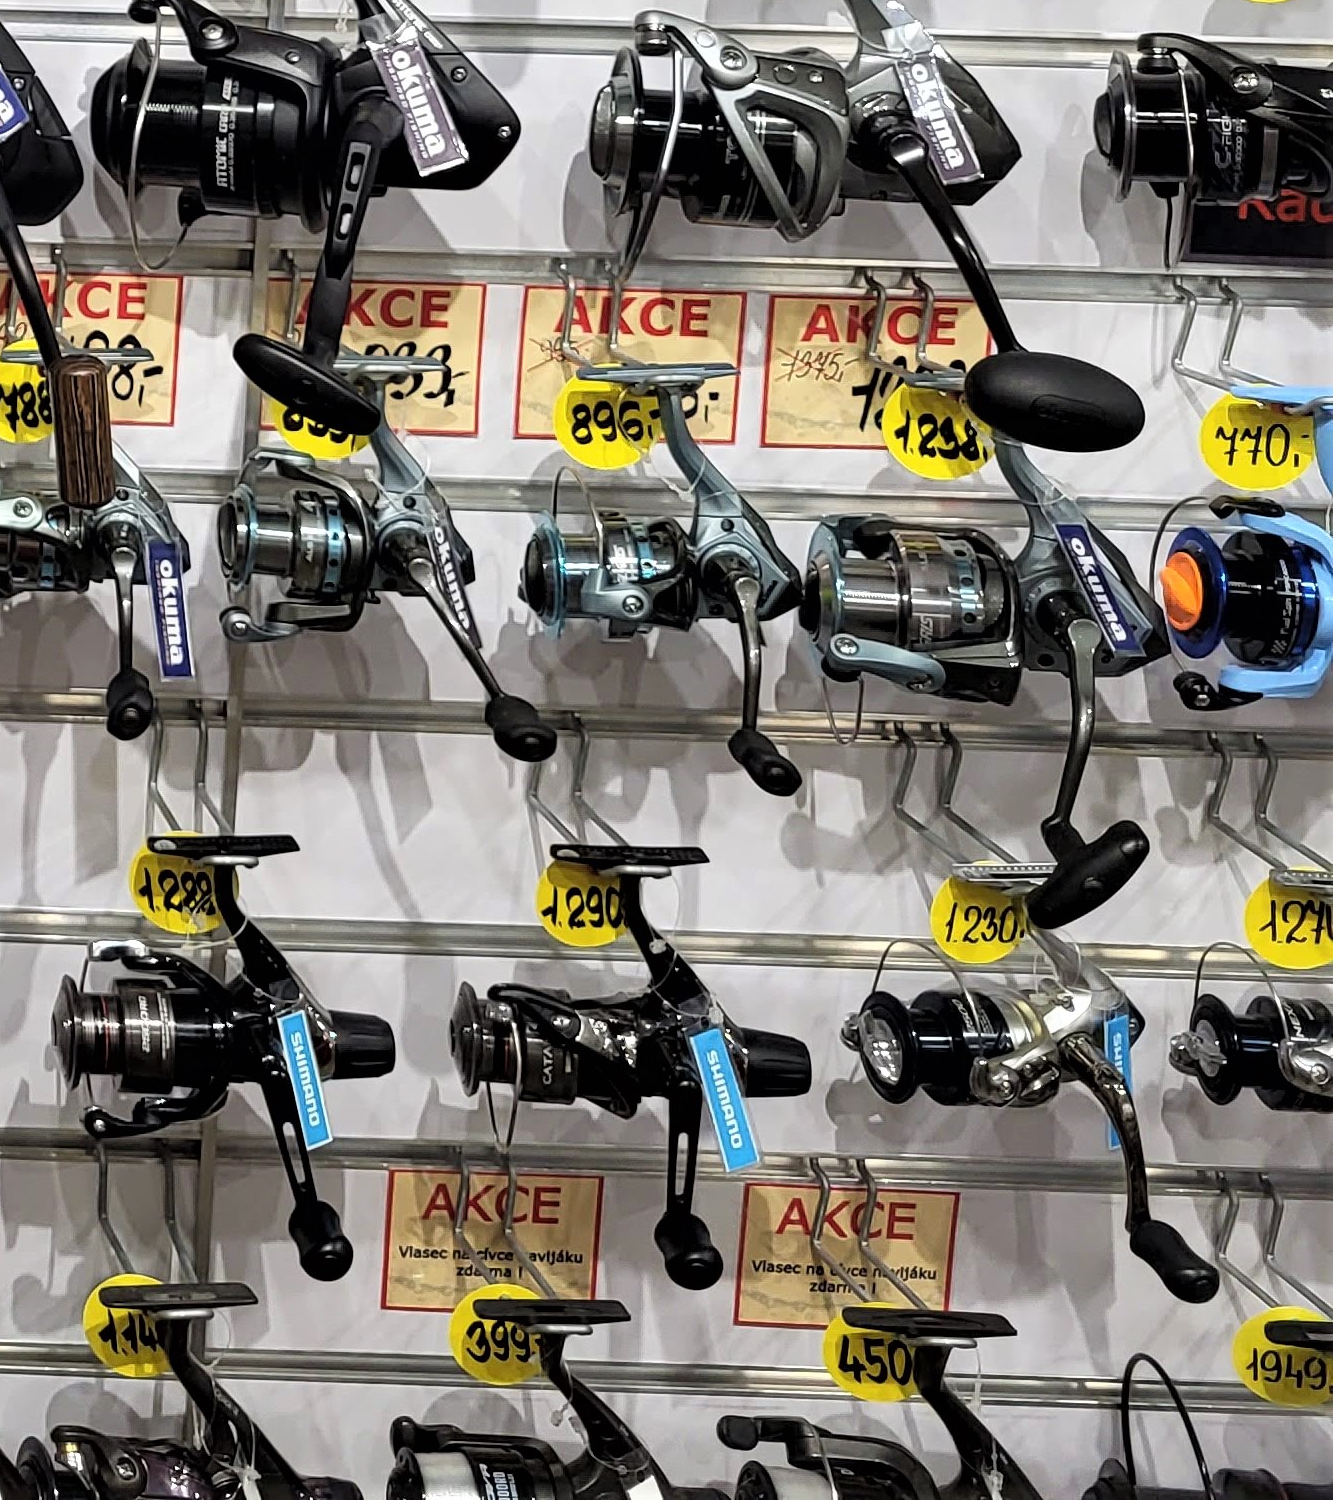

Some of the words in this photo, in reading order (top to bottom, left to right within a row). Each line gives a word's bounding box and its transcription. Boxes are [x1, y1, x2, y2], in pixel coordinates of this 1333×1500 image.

[391, 49, 448, 157] okuma
[912, 63, 966, 170] okuma
[295, 286, 452, 329] KCE
[554, 295, 712, 338] AKCE
[799, 303, 960, 346] AKCE
[159, 559, 186, 666] okuma
[433, 526, 472, 632] okuma
[1072, 536, 1129, 643] okuma
[291, 1030, 319, 1128] SHIMANO
[704, 1049, 742, 1150] SHIMANO
[421, 1182, 562, 1225] AKCE
[775, 1197, 918, 1241] AKCE
[398, 1245, 448, 1260] Vlasec
[520, 1248, 584, 1266] avijáku
[751, 1260, 801, 1275] Vlasec
